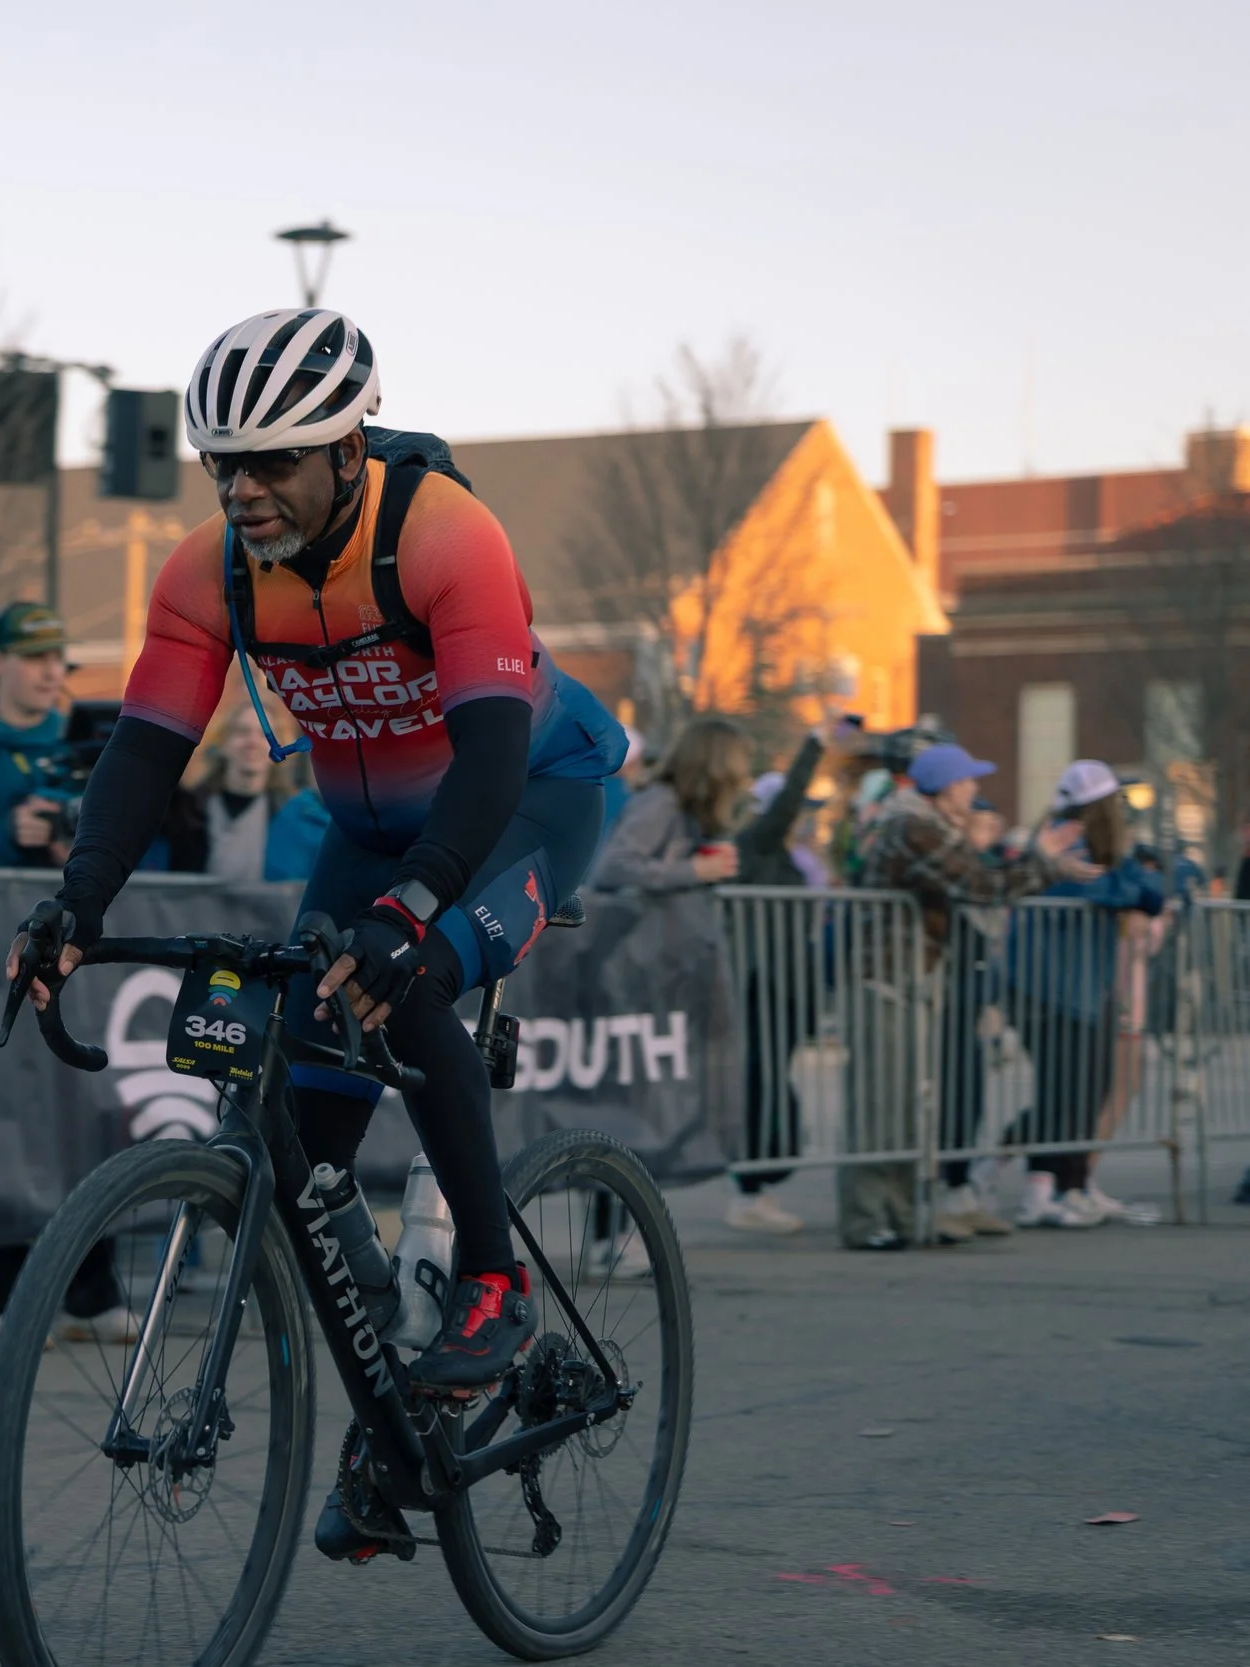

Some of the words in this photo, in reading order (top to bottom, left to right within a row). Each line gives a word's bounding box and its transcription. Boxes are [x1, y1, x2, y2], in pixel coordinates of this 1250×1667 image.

[497, 658, 526, 675] ELIEL
[279, 671, 438, 711] AYLOR
[299, 709, 444, 740] RAVEL
[474, 905, 505, 941] ELIEL
[184, 1015, 247, 1045] 346
[194, 1040, 212, 1050] 100
[212, 1043, 235, 1054] MILE
[297, 1174, 395, 1398] VIATHON
